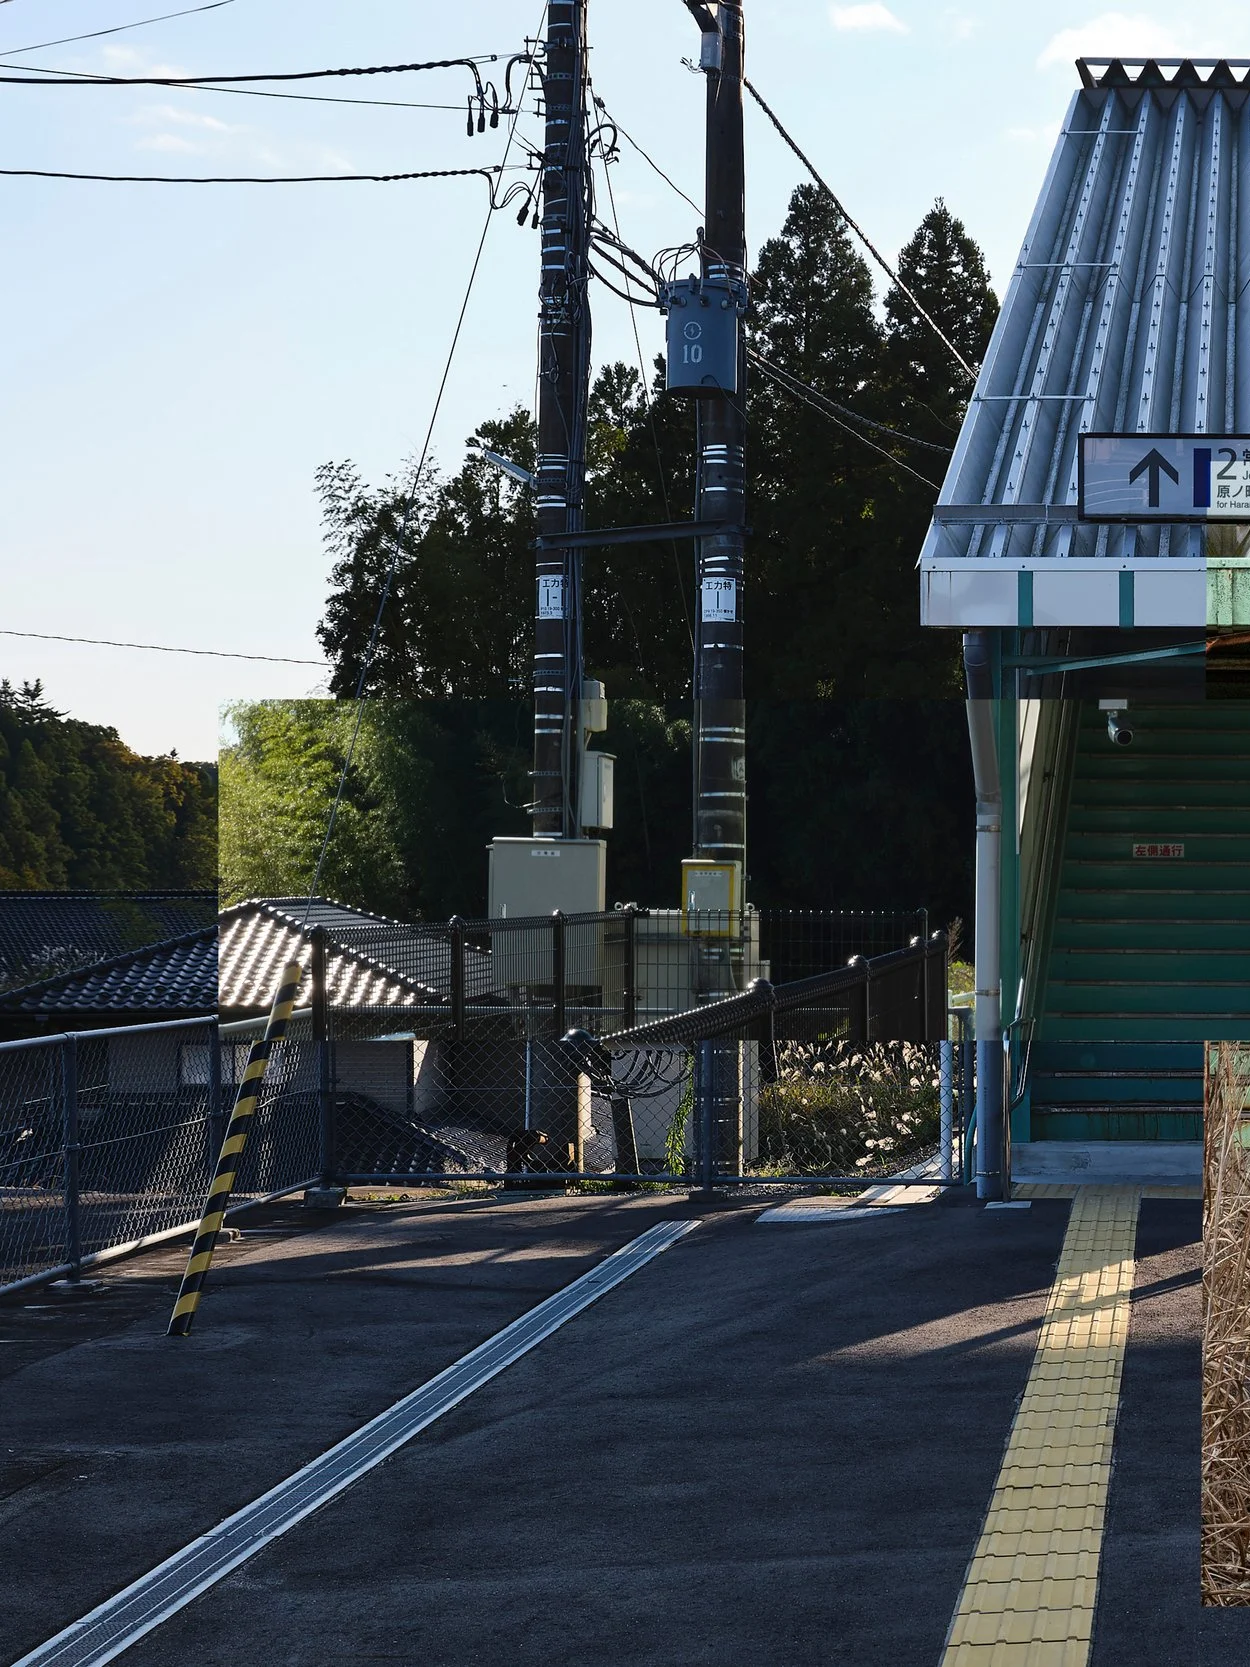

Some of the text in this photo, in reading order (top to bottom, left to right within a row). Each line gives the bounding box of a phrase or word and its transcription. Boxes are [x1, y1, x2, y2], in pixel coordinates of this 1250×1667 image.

[682, 344, 702, 363] 10
[1216, 448, 1237, 480] 2
[1216, 501, 1228, 509] for
[1135, 844, 1183, 857] 左側通行
